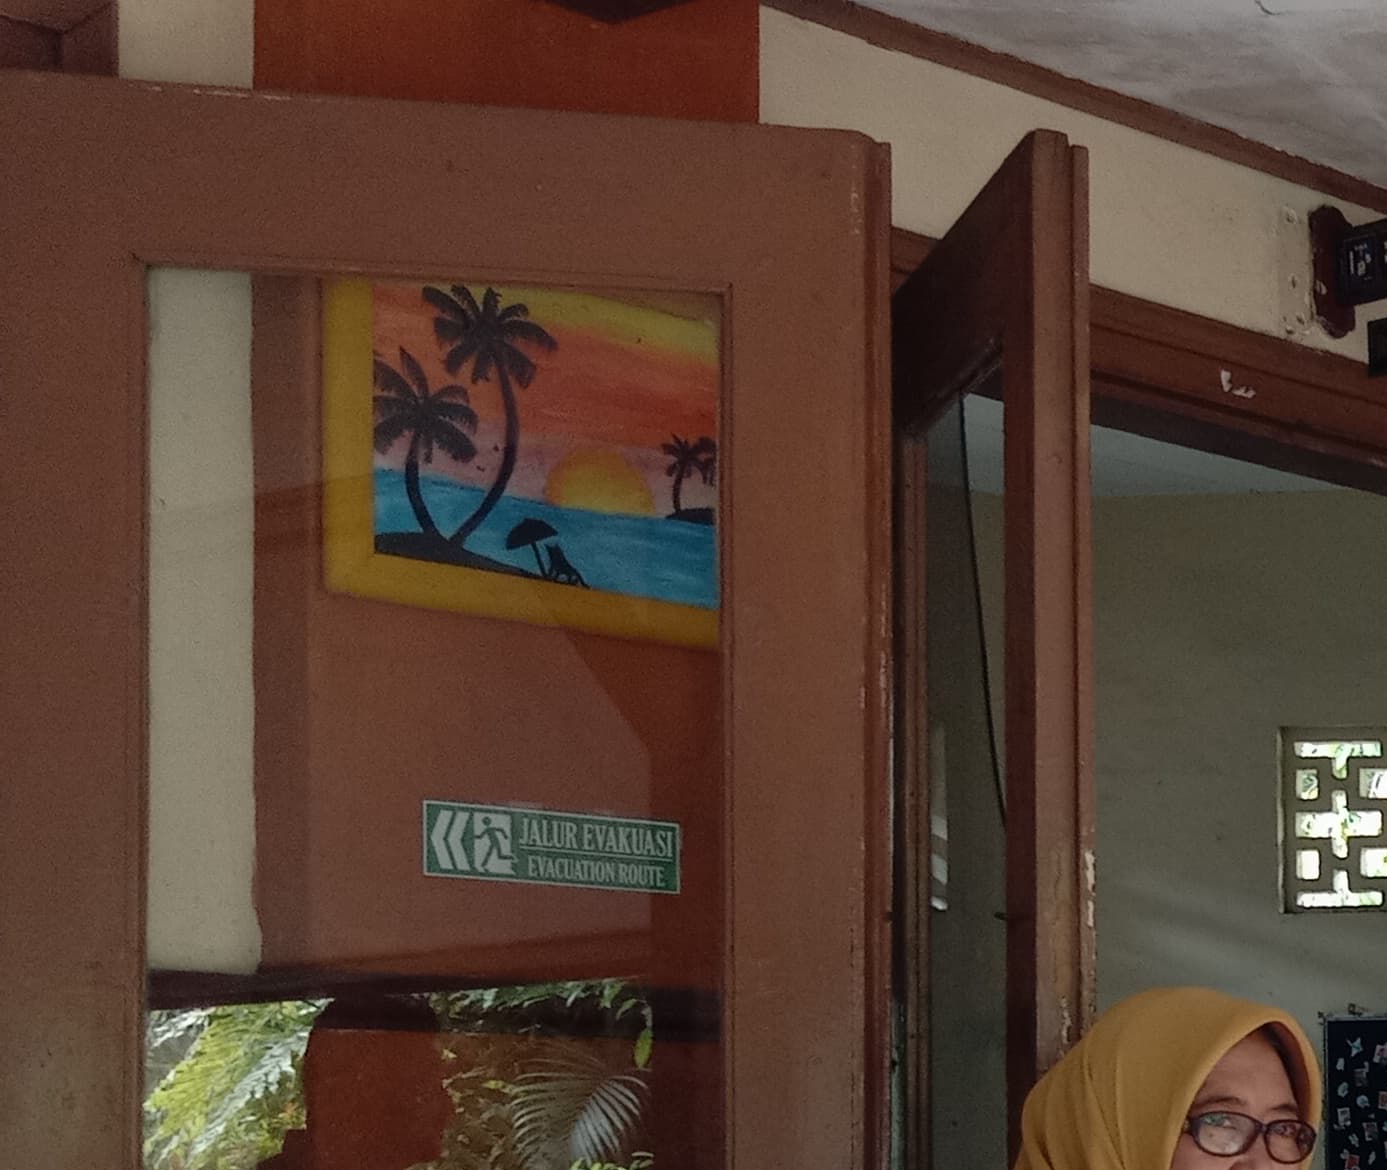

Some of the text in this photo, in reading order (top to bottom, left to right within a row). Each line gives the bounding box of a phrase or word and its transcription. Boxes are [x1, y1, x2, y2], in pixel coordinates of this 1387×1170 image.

[519, 817, 674, 858] JALUR EVAKUASI
[528, 855, 666, 888] EVACUATION ROUTE
